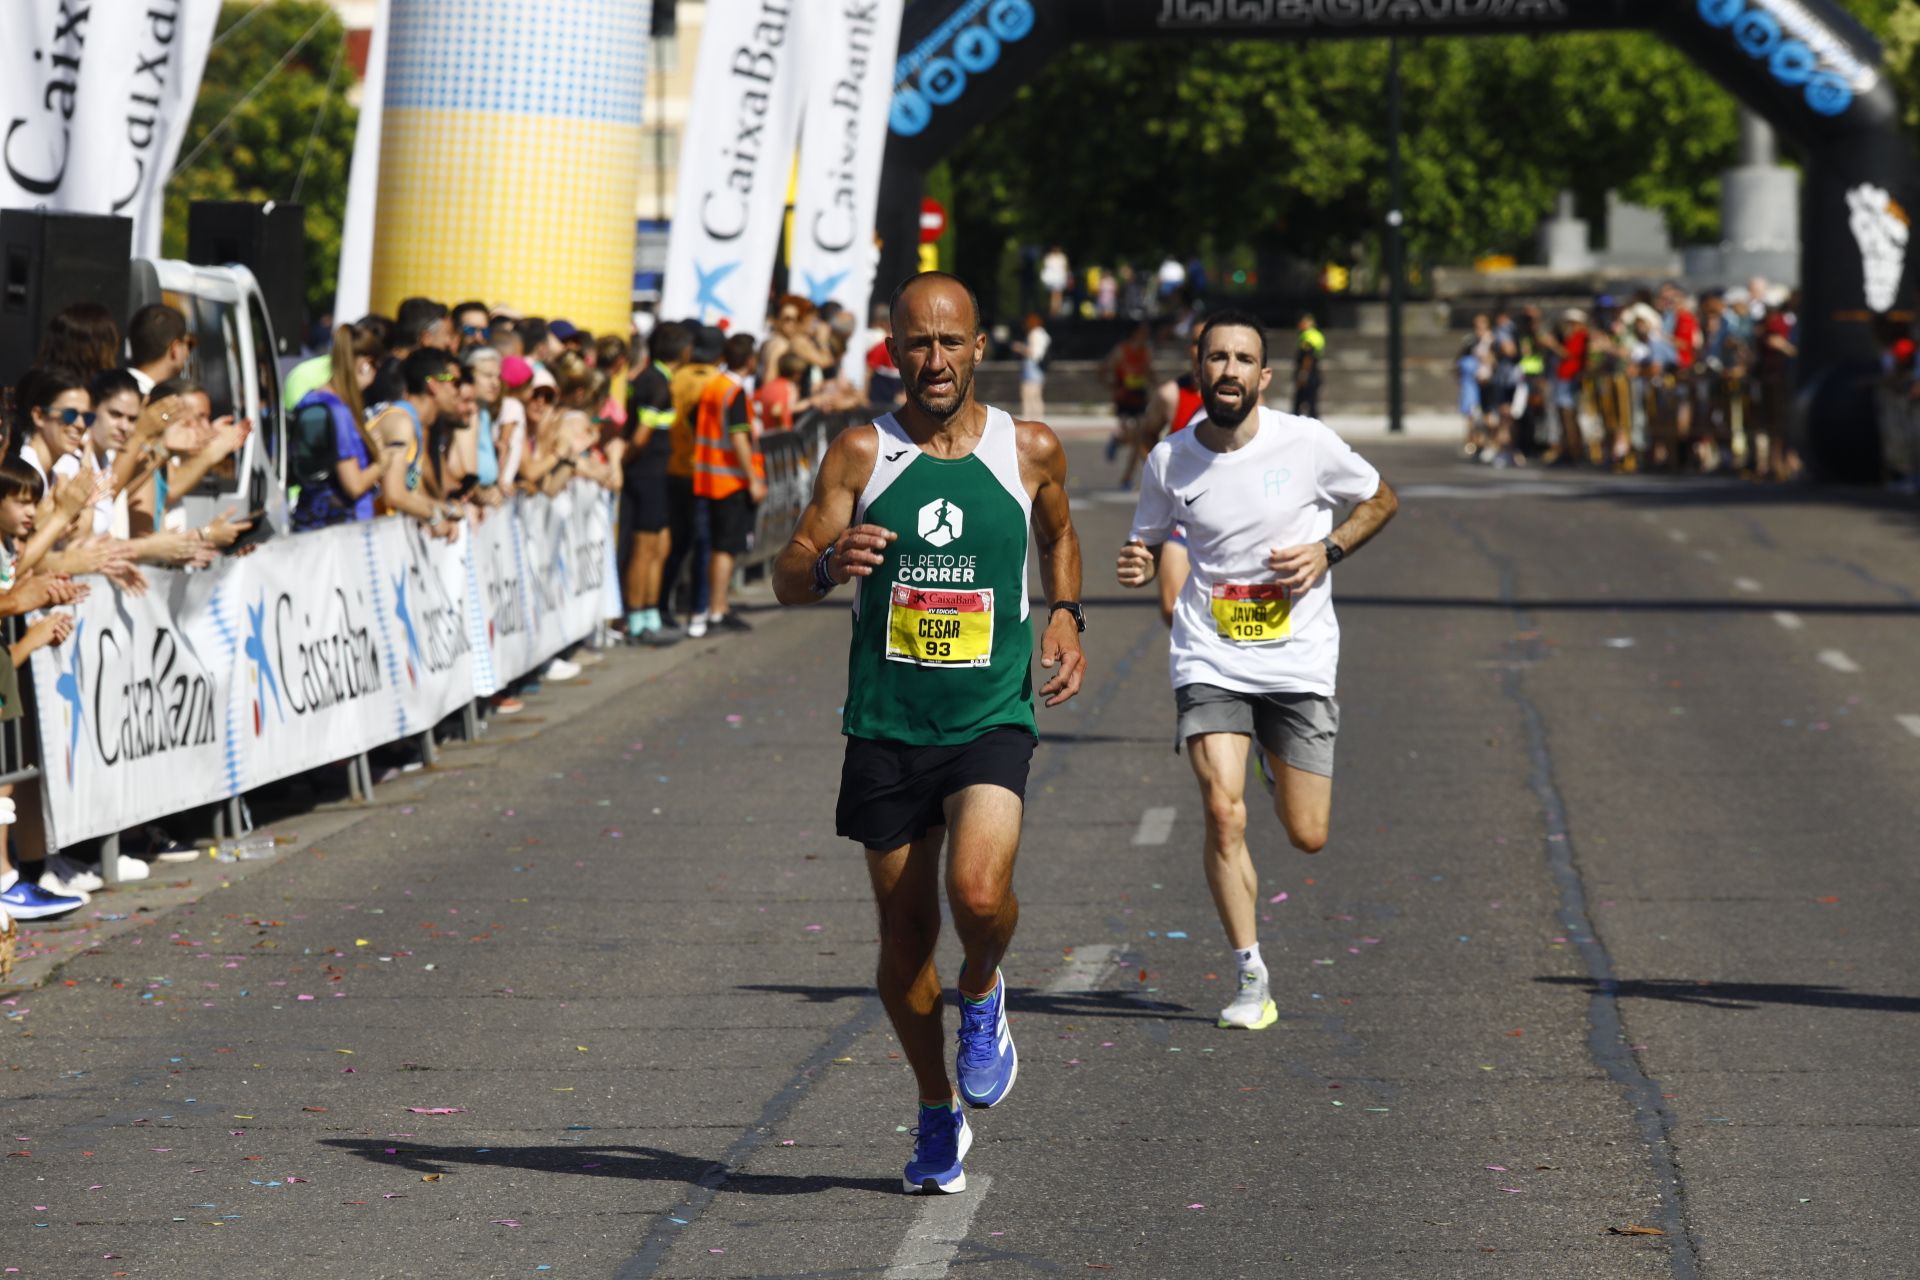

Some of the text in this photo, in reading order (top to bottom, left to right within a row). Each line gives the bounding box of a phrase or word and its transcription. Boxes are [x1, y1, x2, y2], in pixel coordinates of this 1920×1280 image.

[900, 554, 977, 568] EL RETO DE
[899, 567, 975, 582] CORRER
[929, 592, 977, 605] CaixaBank
[1231, 606, 1267, 622] JAVIER
[918, 618, 961, 639] CESAR
[1234, 625, 1263, 636] 109
[926, 641, 951, 656] 93
